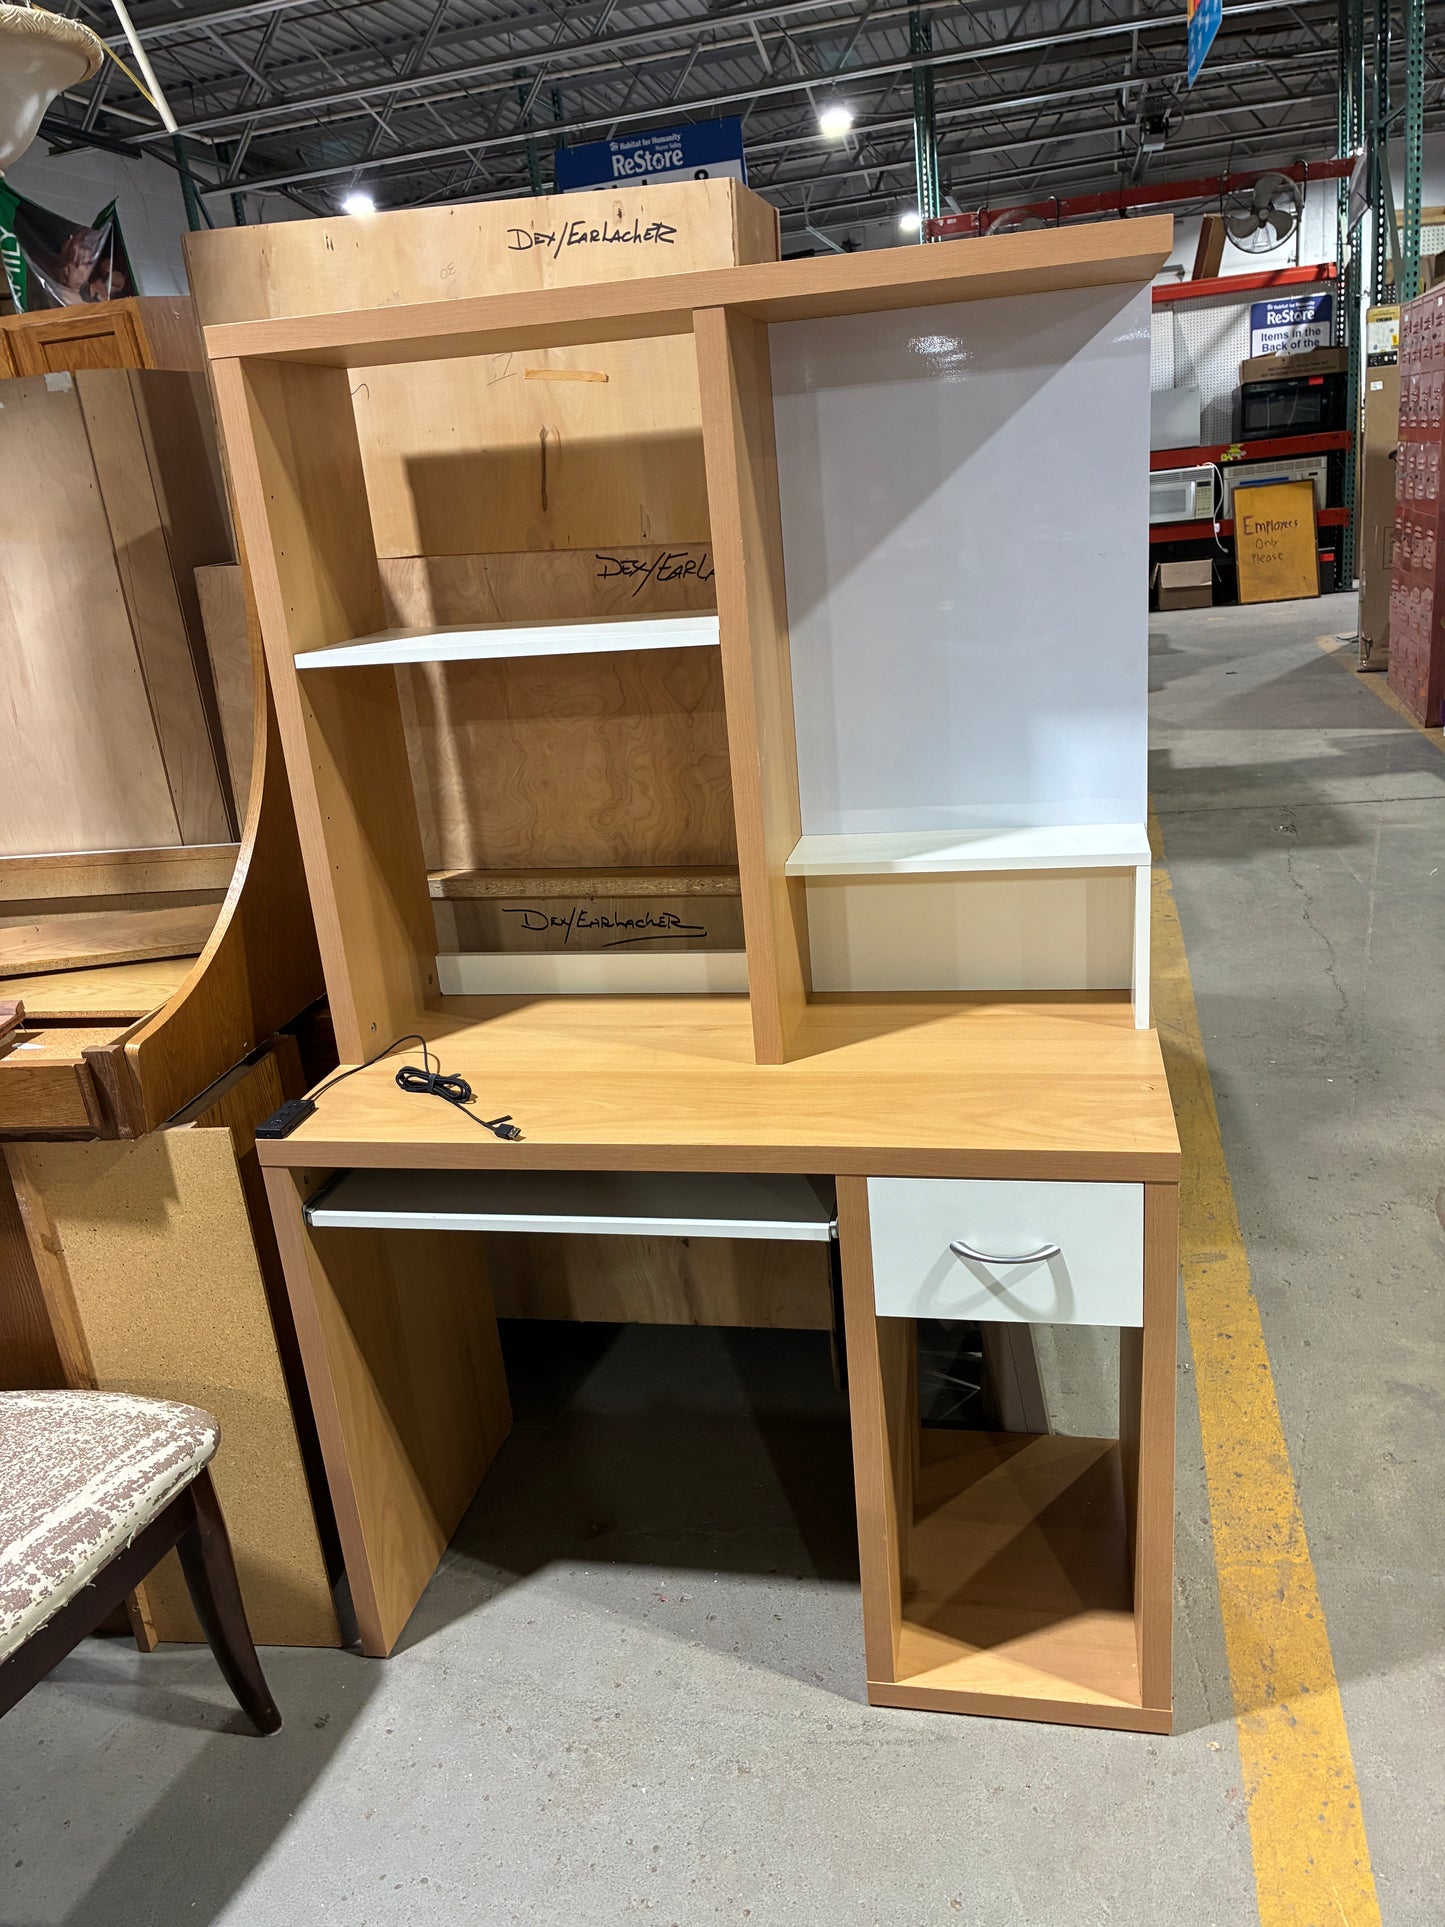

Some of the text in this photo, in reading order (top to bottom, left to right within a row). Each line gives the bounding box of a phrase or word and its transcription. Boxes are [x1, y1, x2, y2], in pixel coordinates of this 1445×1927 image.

[619, 133, 682, 150] Habitat for Humanity
[611, 150, 684, 177] ReStore
[1266, 309, 1316, 325] ReStore
[1261, 327, 1322, 342] Items in the
[1261, 338, 1320, 353] Back of the
[1242, 515, 1298, 535] Employees
[1255, 538, 1278, 549] Only
